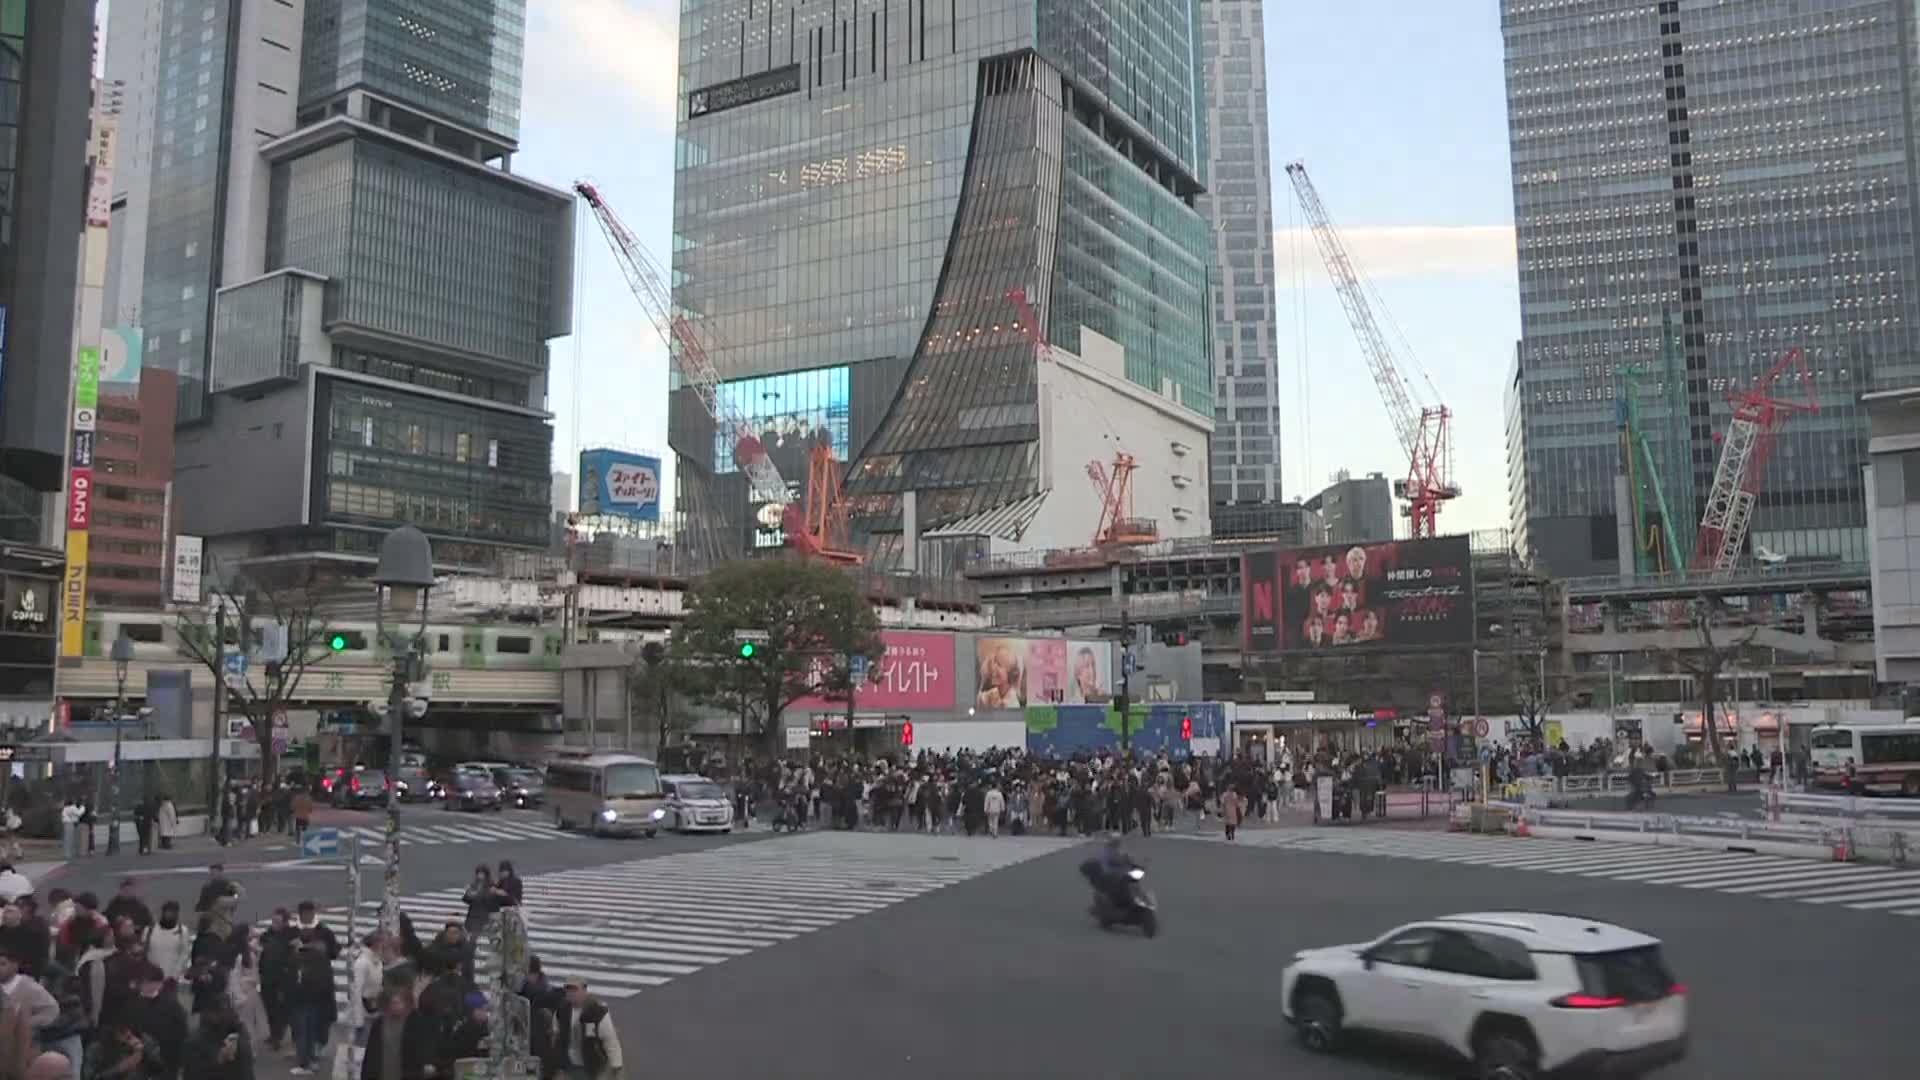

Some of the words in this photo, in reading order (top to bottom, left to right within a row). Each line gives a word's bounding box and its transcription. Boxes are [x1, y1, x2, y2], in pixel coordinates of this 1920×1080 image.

[67, 565, 82, 621] プロミス
[11, 610, 44, 622] COFFEE
[326, 672, 450, 690] 渋駅
